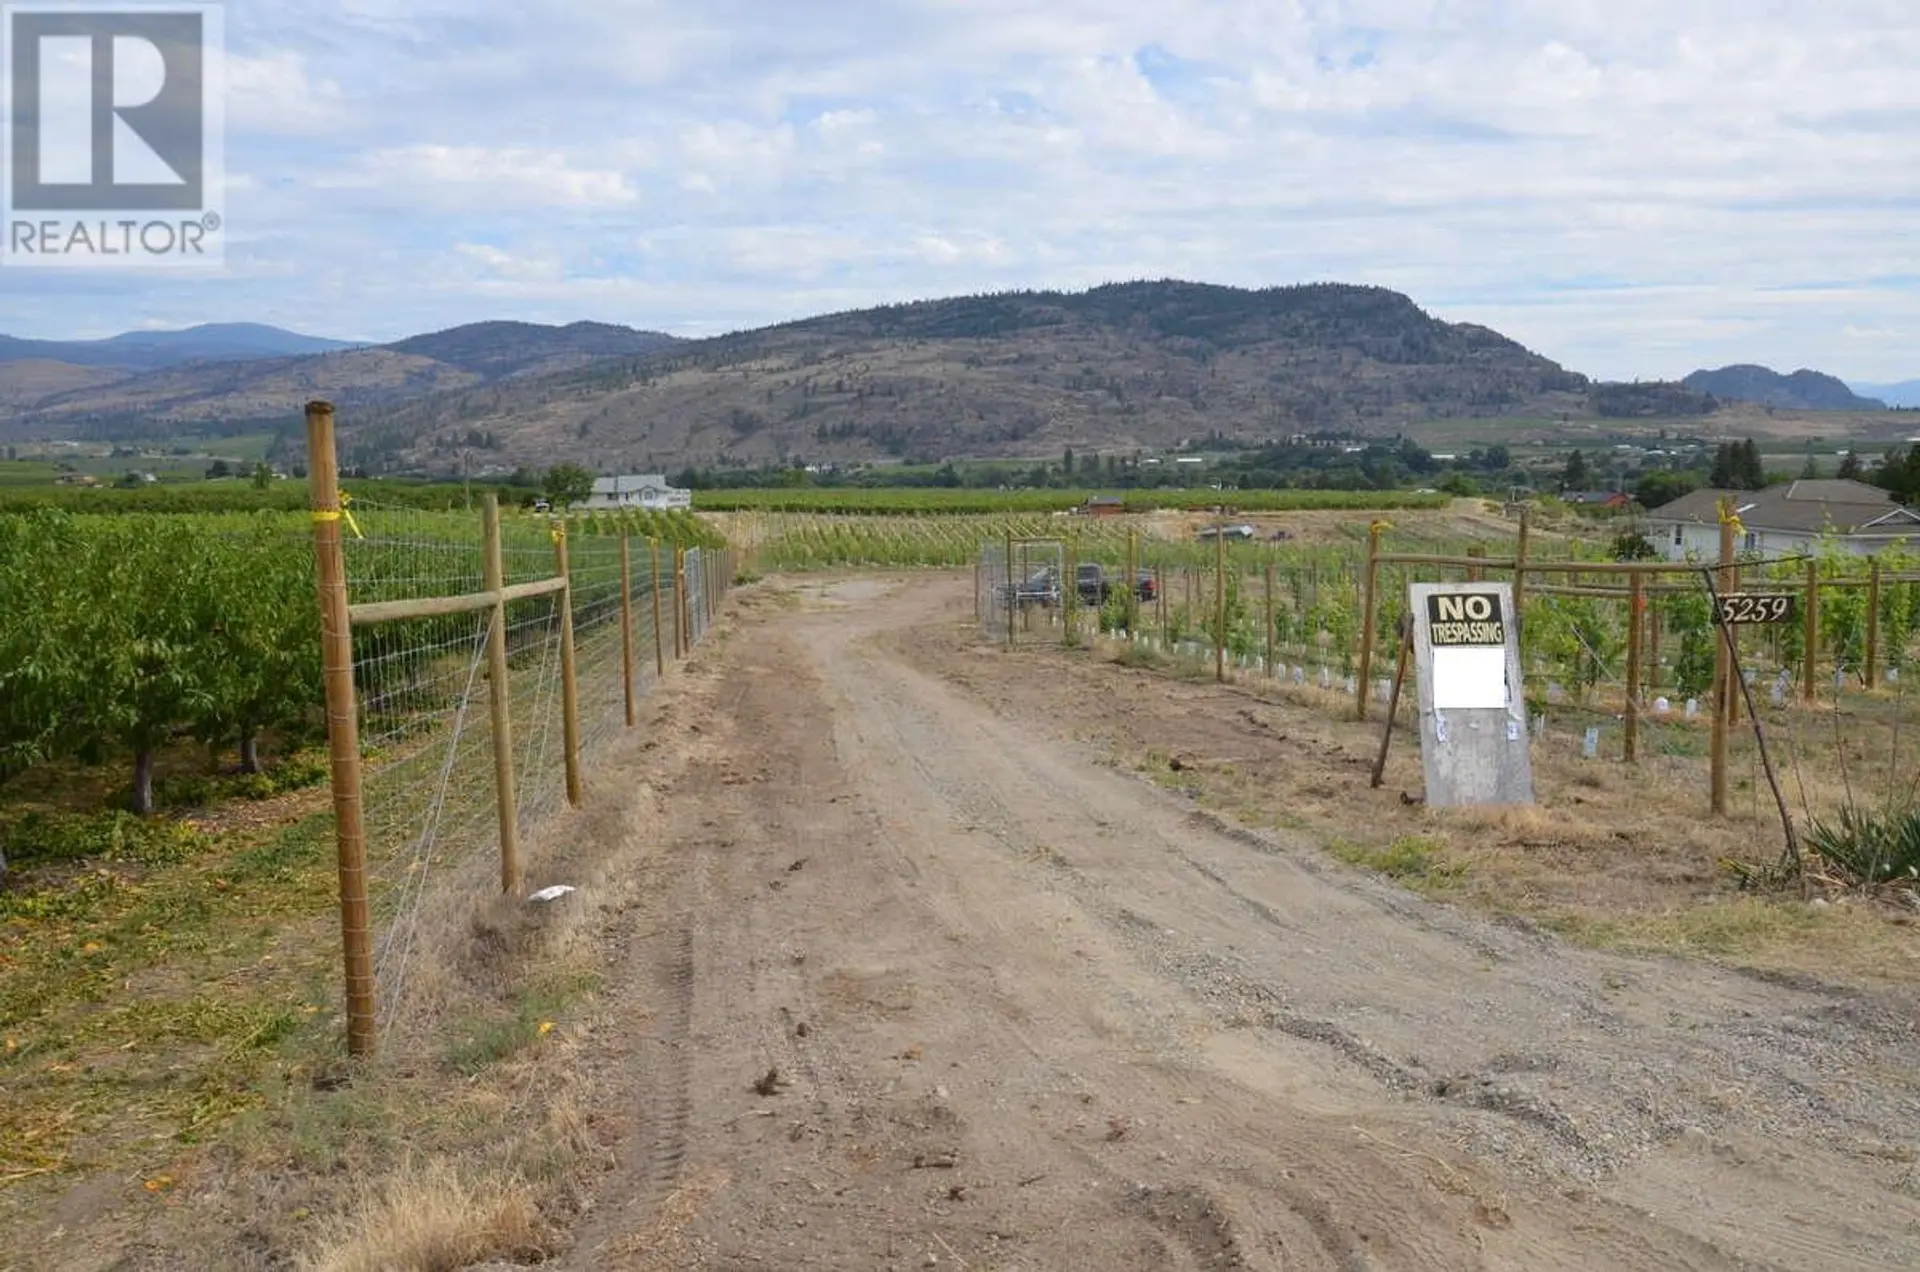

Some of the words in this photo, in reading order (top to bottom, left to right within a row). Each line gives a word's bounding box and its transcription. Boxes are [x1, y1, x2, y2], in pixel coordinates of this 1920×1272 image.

[1438, 596, 1491, 620] NO
[1723, 597, 1787, 622] 5259
[1432, 622, 1503, 643] TRESPASSING
